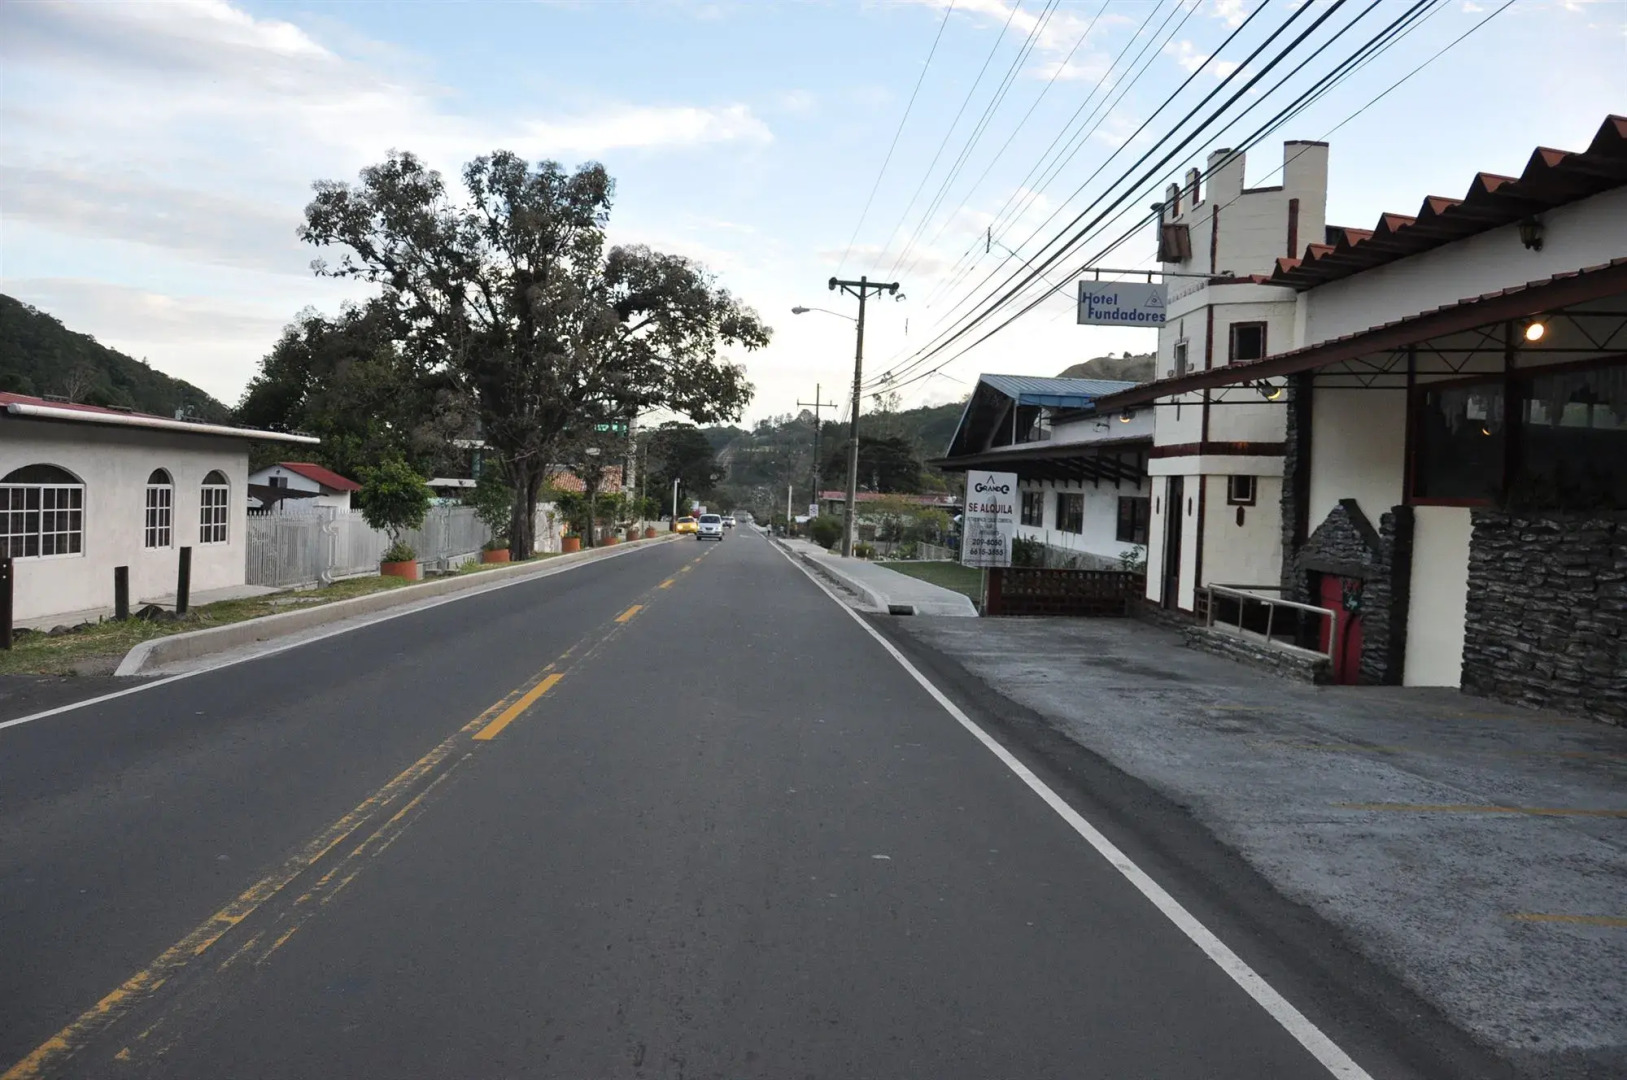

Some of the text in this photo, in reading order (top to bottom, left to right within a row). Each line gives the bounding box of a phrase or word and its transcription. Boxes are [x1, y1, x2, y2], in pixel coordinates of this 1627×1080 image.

[1082, 292, 1118, 305] Hotel
[1088, 307, 1166, 322] Fundadores
[968, 502, 1013, 514] SE ALQUILA
